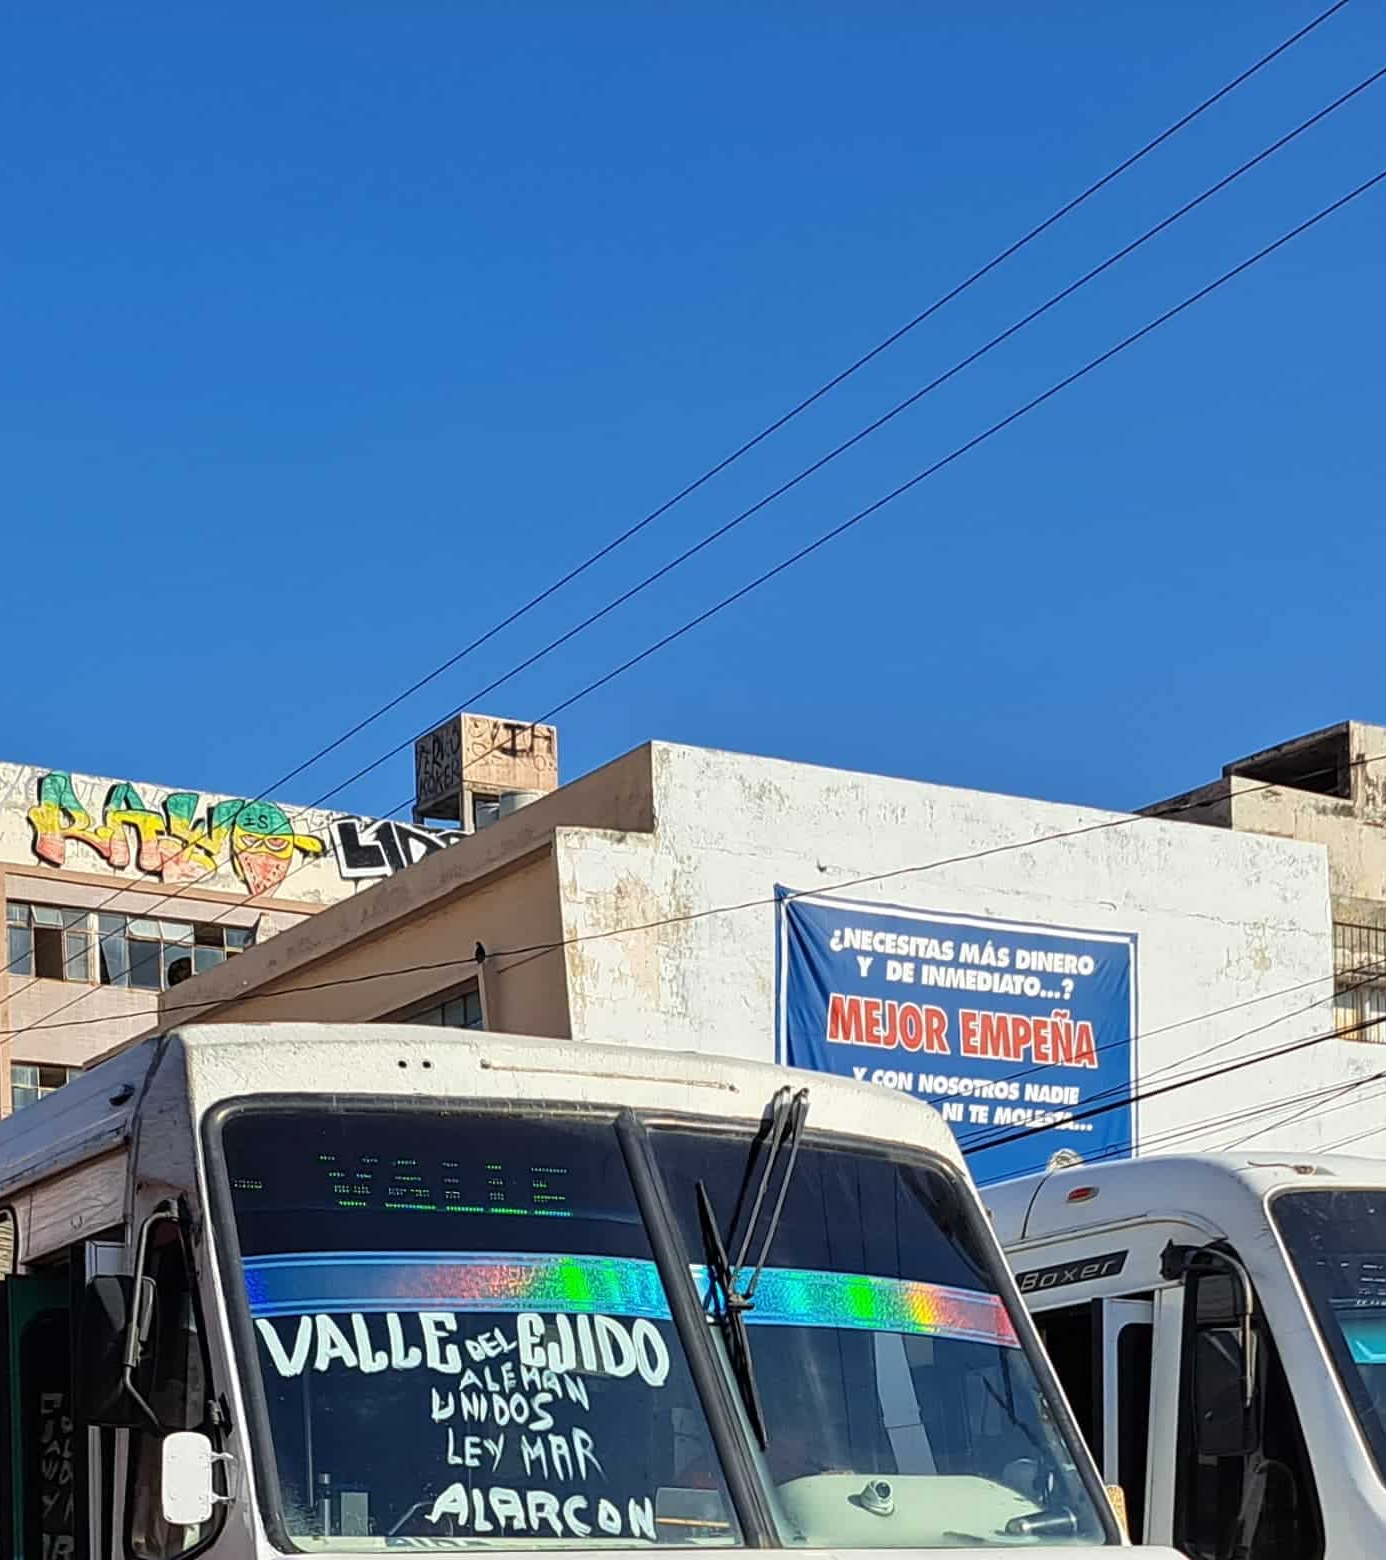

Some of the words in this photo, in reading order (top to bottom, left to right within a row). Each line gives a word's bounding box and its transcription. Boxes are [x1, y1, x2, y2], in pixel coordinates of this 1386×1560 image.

[830, 927, 954, 962] ¿NECESITAS
[959, 940, 1010, 968] MÁS
[1015, 952, 1094, 976] DINERO
[857, 956, 871, 978] Y
[885, 959, 915, 984] DE
[921, 966, 1074, 1000] INMEDIATO...?
[827, 993, 950, 1055] MEJOR
[960, 1009, 1098, 1068] EMPEÑA
[871, 1069, 913, 1092] CON
[918, 1073, 1020, 1101] NOSOTROS
[1024, 1083, 1080, 1105] NADIE
[968, 1105, 988, 1124] TE
[1020, 1258, 1116, 1291] Boxer
[256, 1312, 462, 1377] VALLE
[464, 1327, 517, 1361] DEL
[517, 1313, 670, 1387] EJIDO
[431, 1387, 554, 1431] UNIDOS
[459, 1361, 590, 1411] ALEMAN
[447, 1427, 504, 1473] LEY
[521, 1427, 606, 1482] MAR
[424, 1482, 657, 1540] ALARCON
